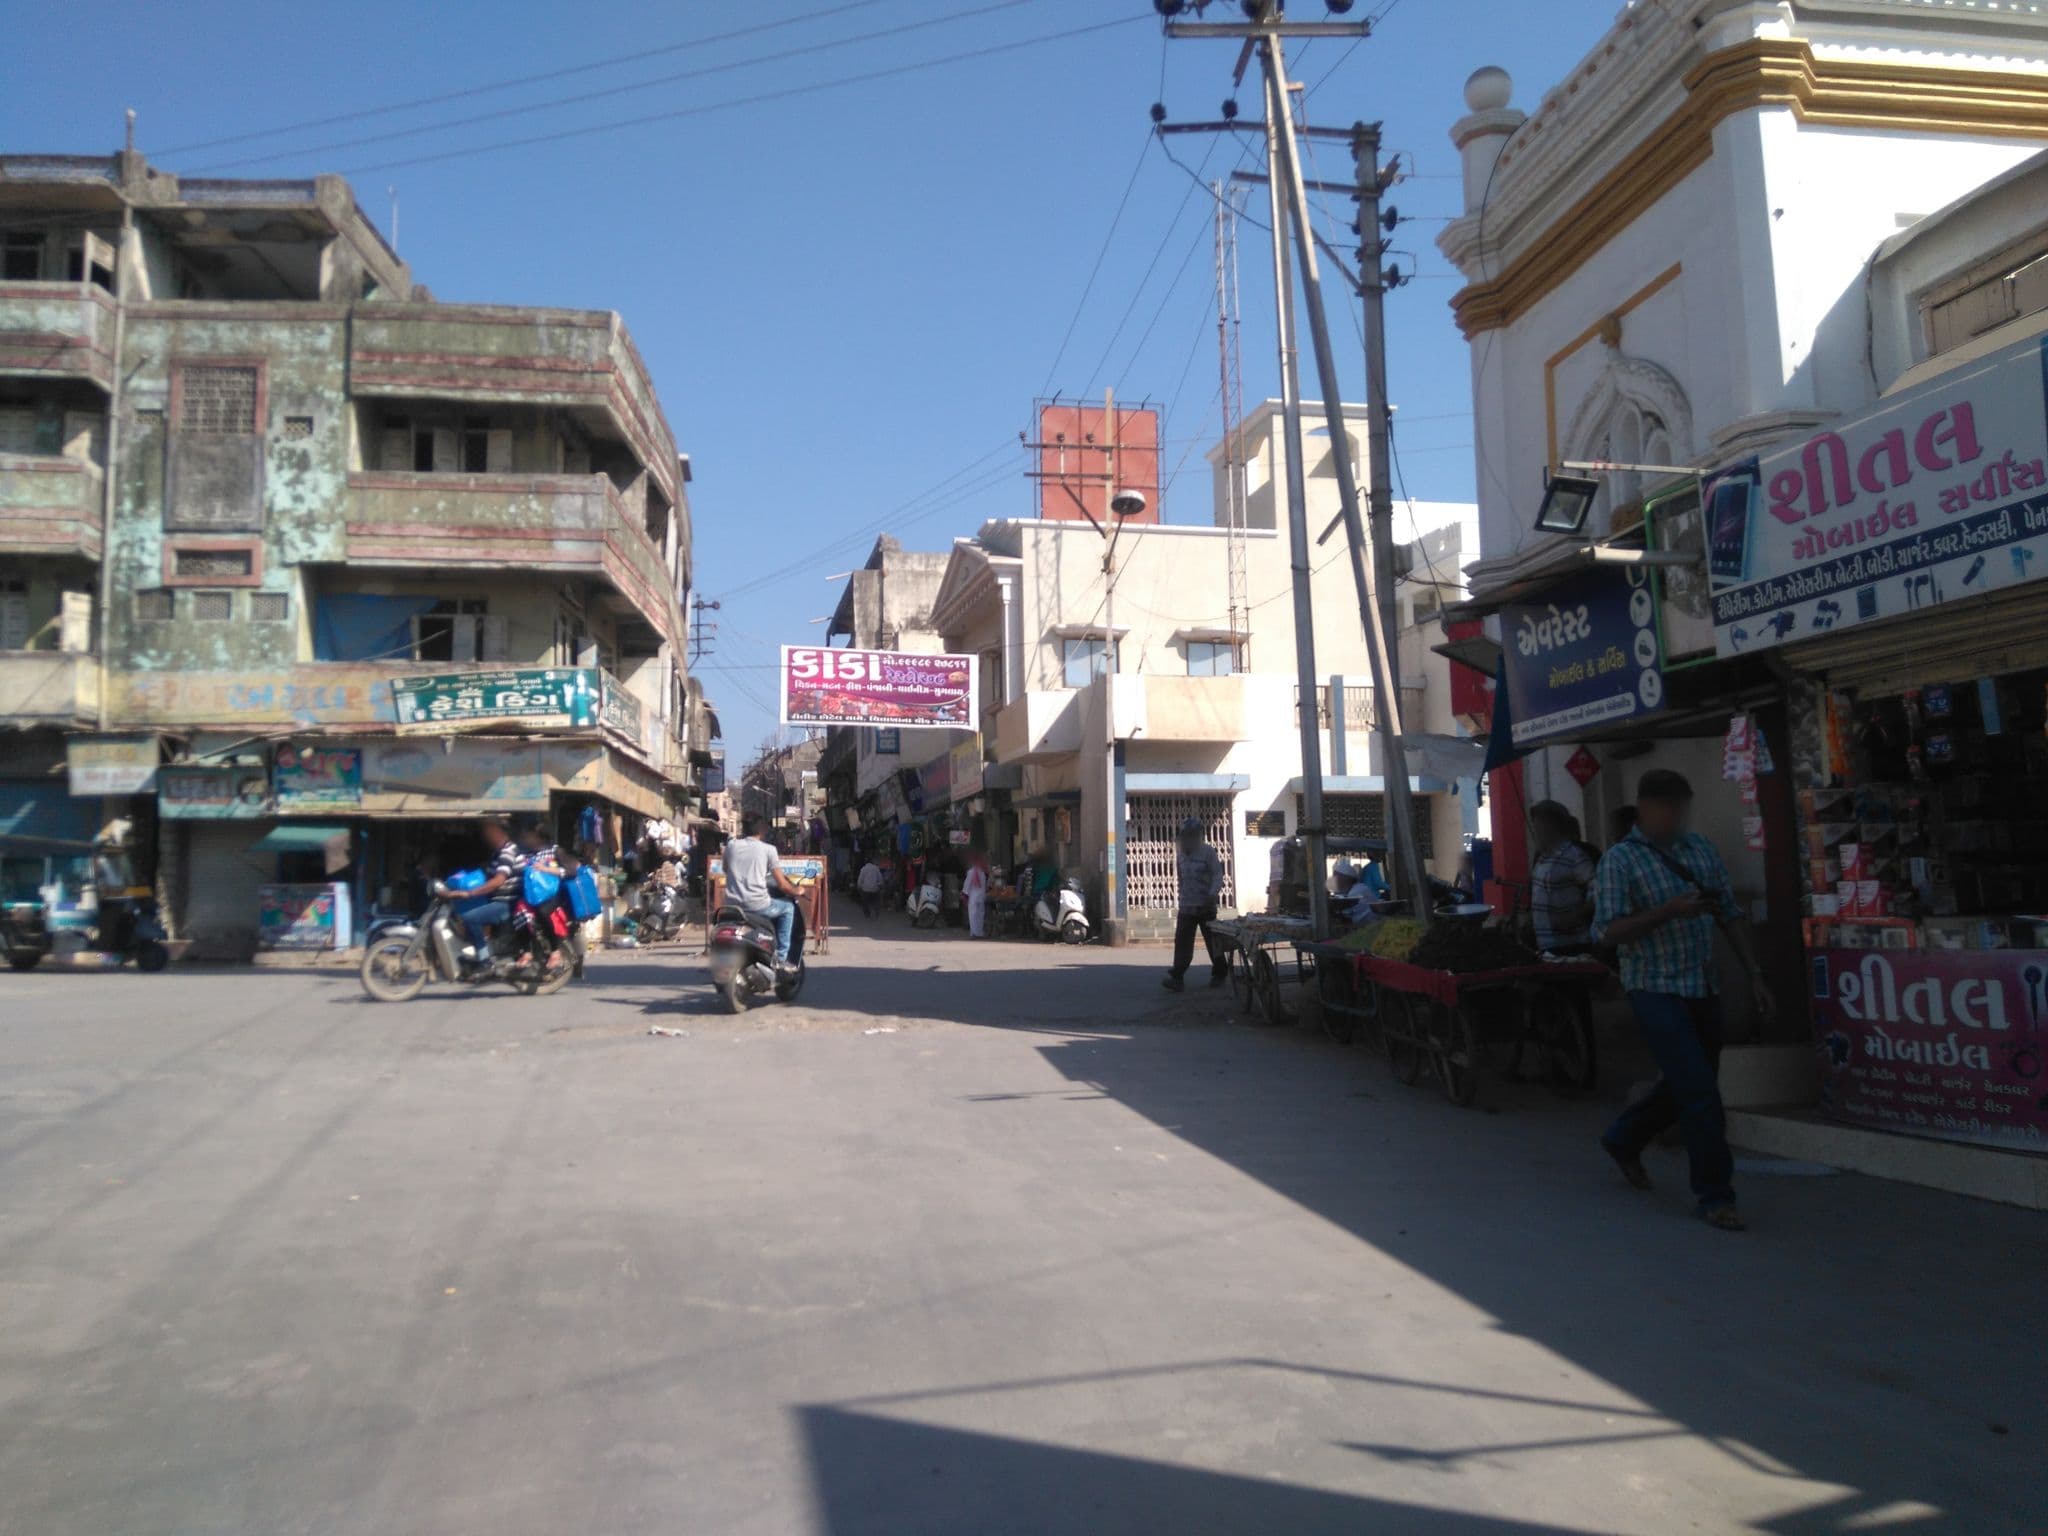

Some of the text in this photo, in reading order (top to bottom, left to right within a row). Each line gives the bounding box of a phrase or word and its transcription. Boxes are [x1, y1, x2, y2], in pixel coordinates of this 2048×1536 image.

[1769, 400, 1983, 524] શીતલ
[1793, 500, 1919, 560] મોબાઈલ
[1517, 603, 1591, 656] એવરેસ્ટ
[791, 650, 882, 681] કાકા
[1838, 953, 2011, 1030] શીતલ
[1864, 1025, 1992, 1071] મોબાઈલ
